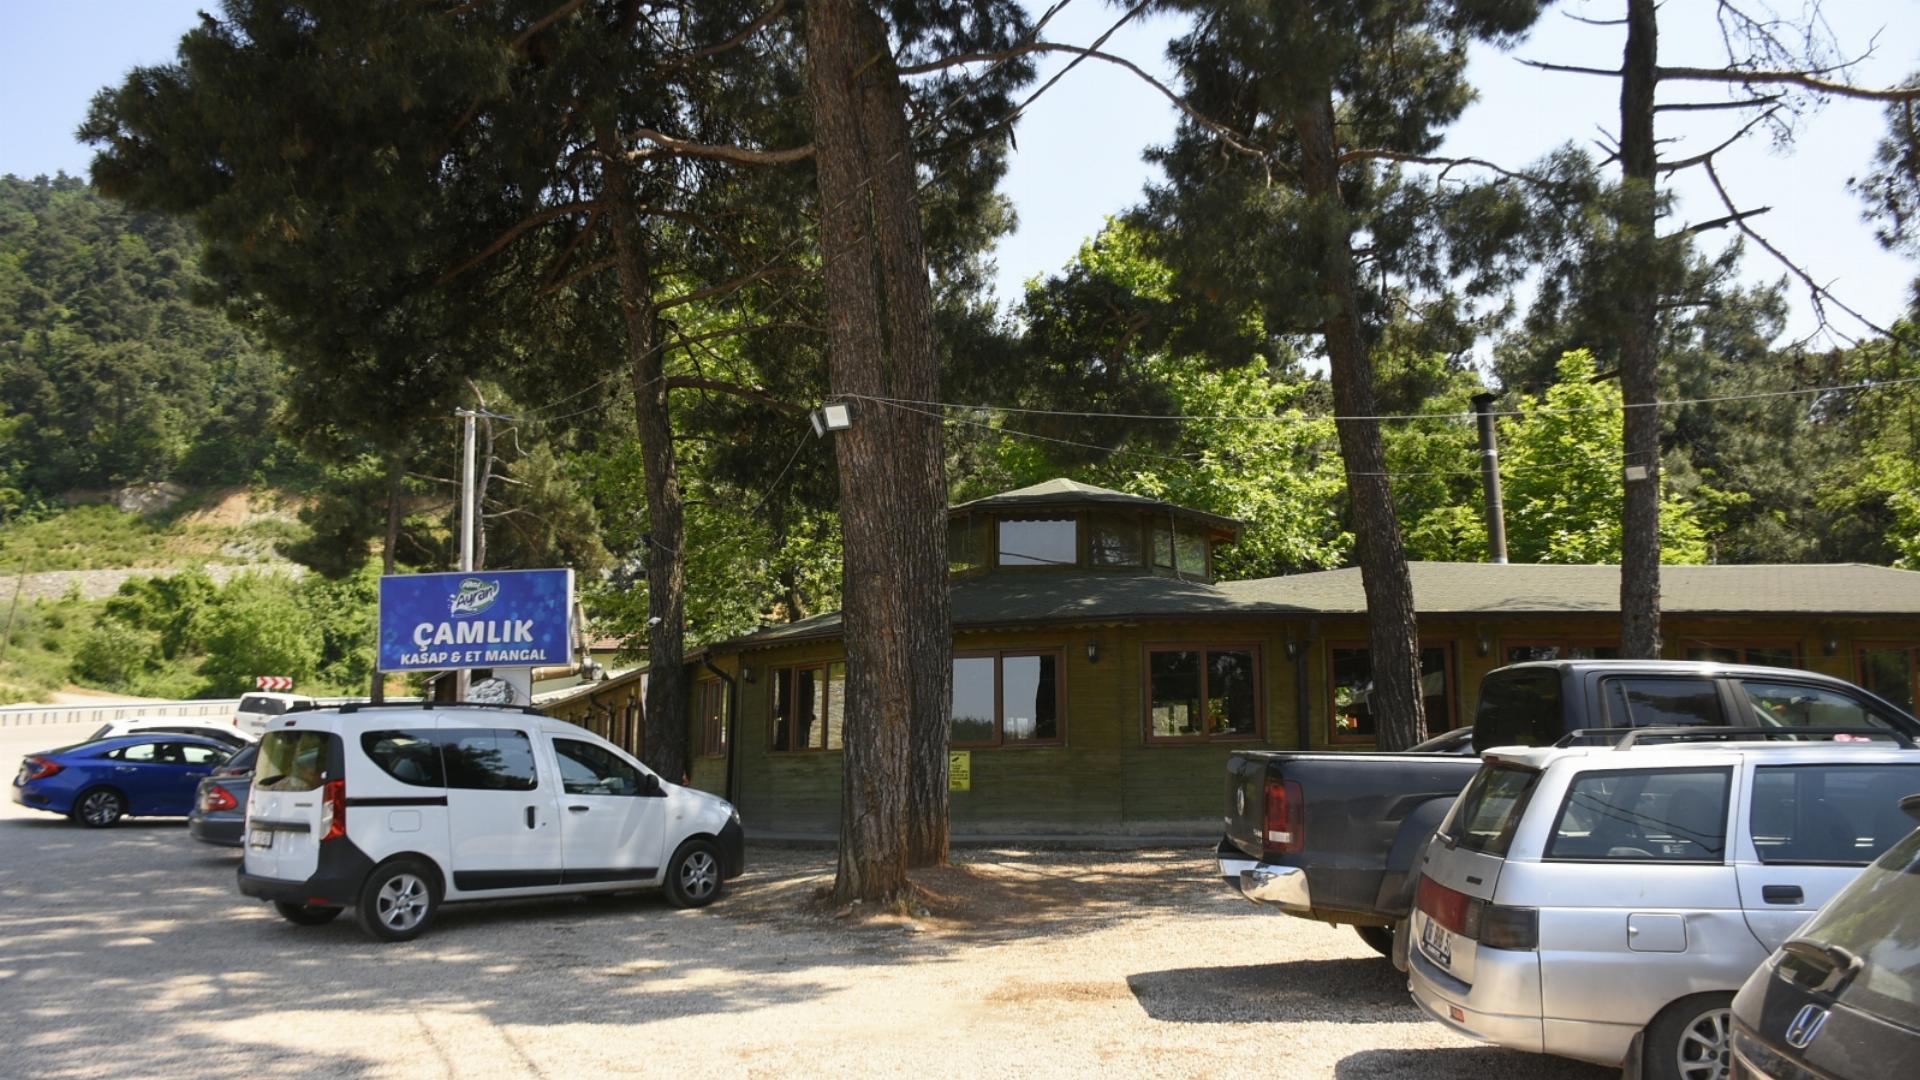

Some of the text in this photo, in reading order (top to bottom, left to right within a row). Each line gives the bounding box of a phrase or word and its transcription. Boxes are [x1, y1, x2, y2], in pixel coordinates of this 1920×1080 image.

[456, 587, 494, 608] Ayran
[413, 619, 534, 652] ÇAMLIK
[400, 648, 547, 665] KASAP & ET MANGAL
